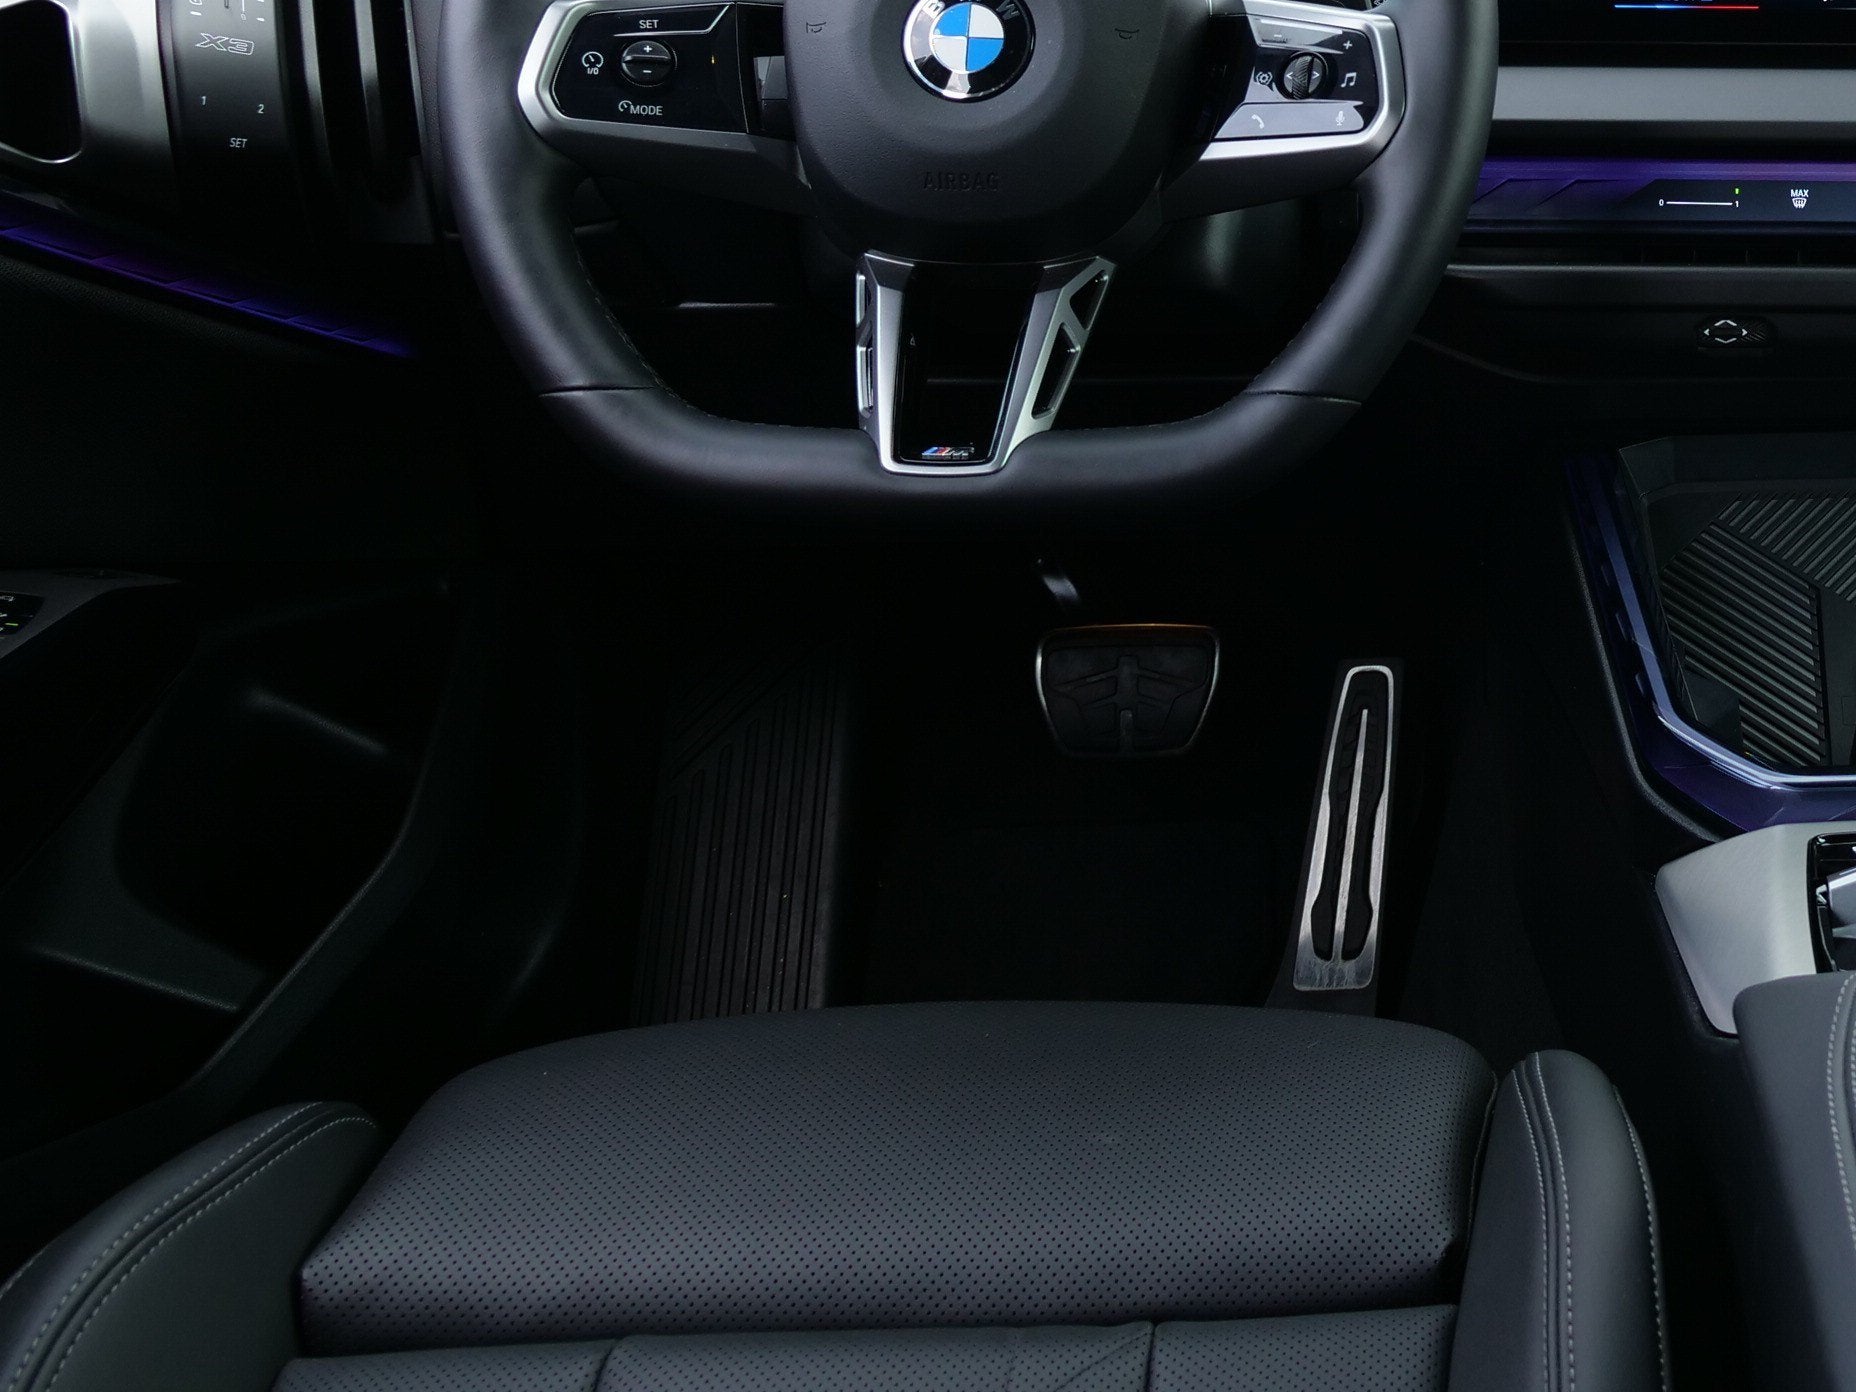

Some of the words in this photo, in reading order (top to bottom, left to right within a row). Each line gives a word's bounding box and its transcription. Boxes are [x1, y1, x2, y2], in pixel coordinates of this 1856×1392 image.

[639, 19, 659, 29] SET
[196, 32, 255, 56] X3
[257, 104, 264, 114] 2
[630, 106, 663, 116] MODE
[229, 138, 247, 149] SET
[923, 171, 999, 192] AIRBAG
[1790, 189, 1809, 198] MAX
